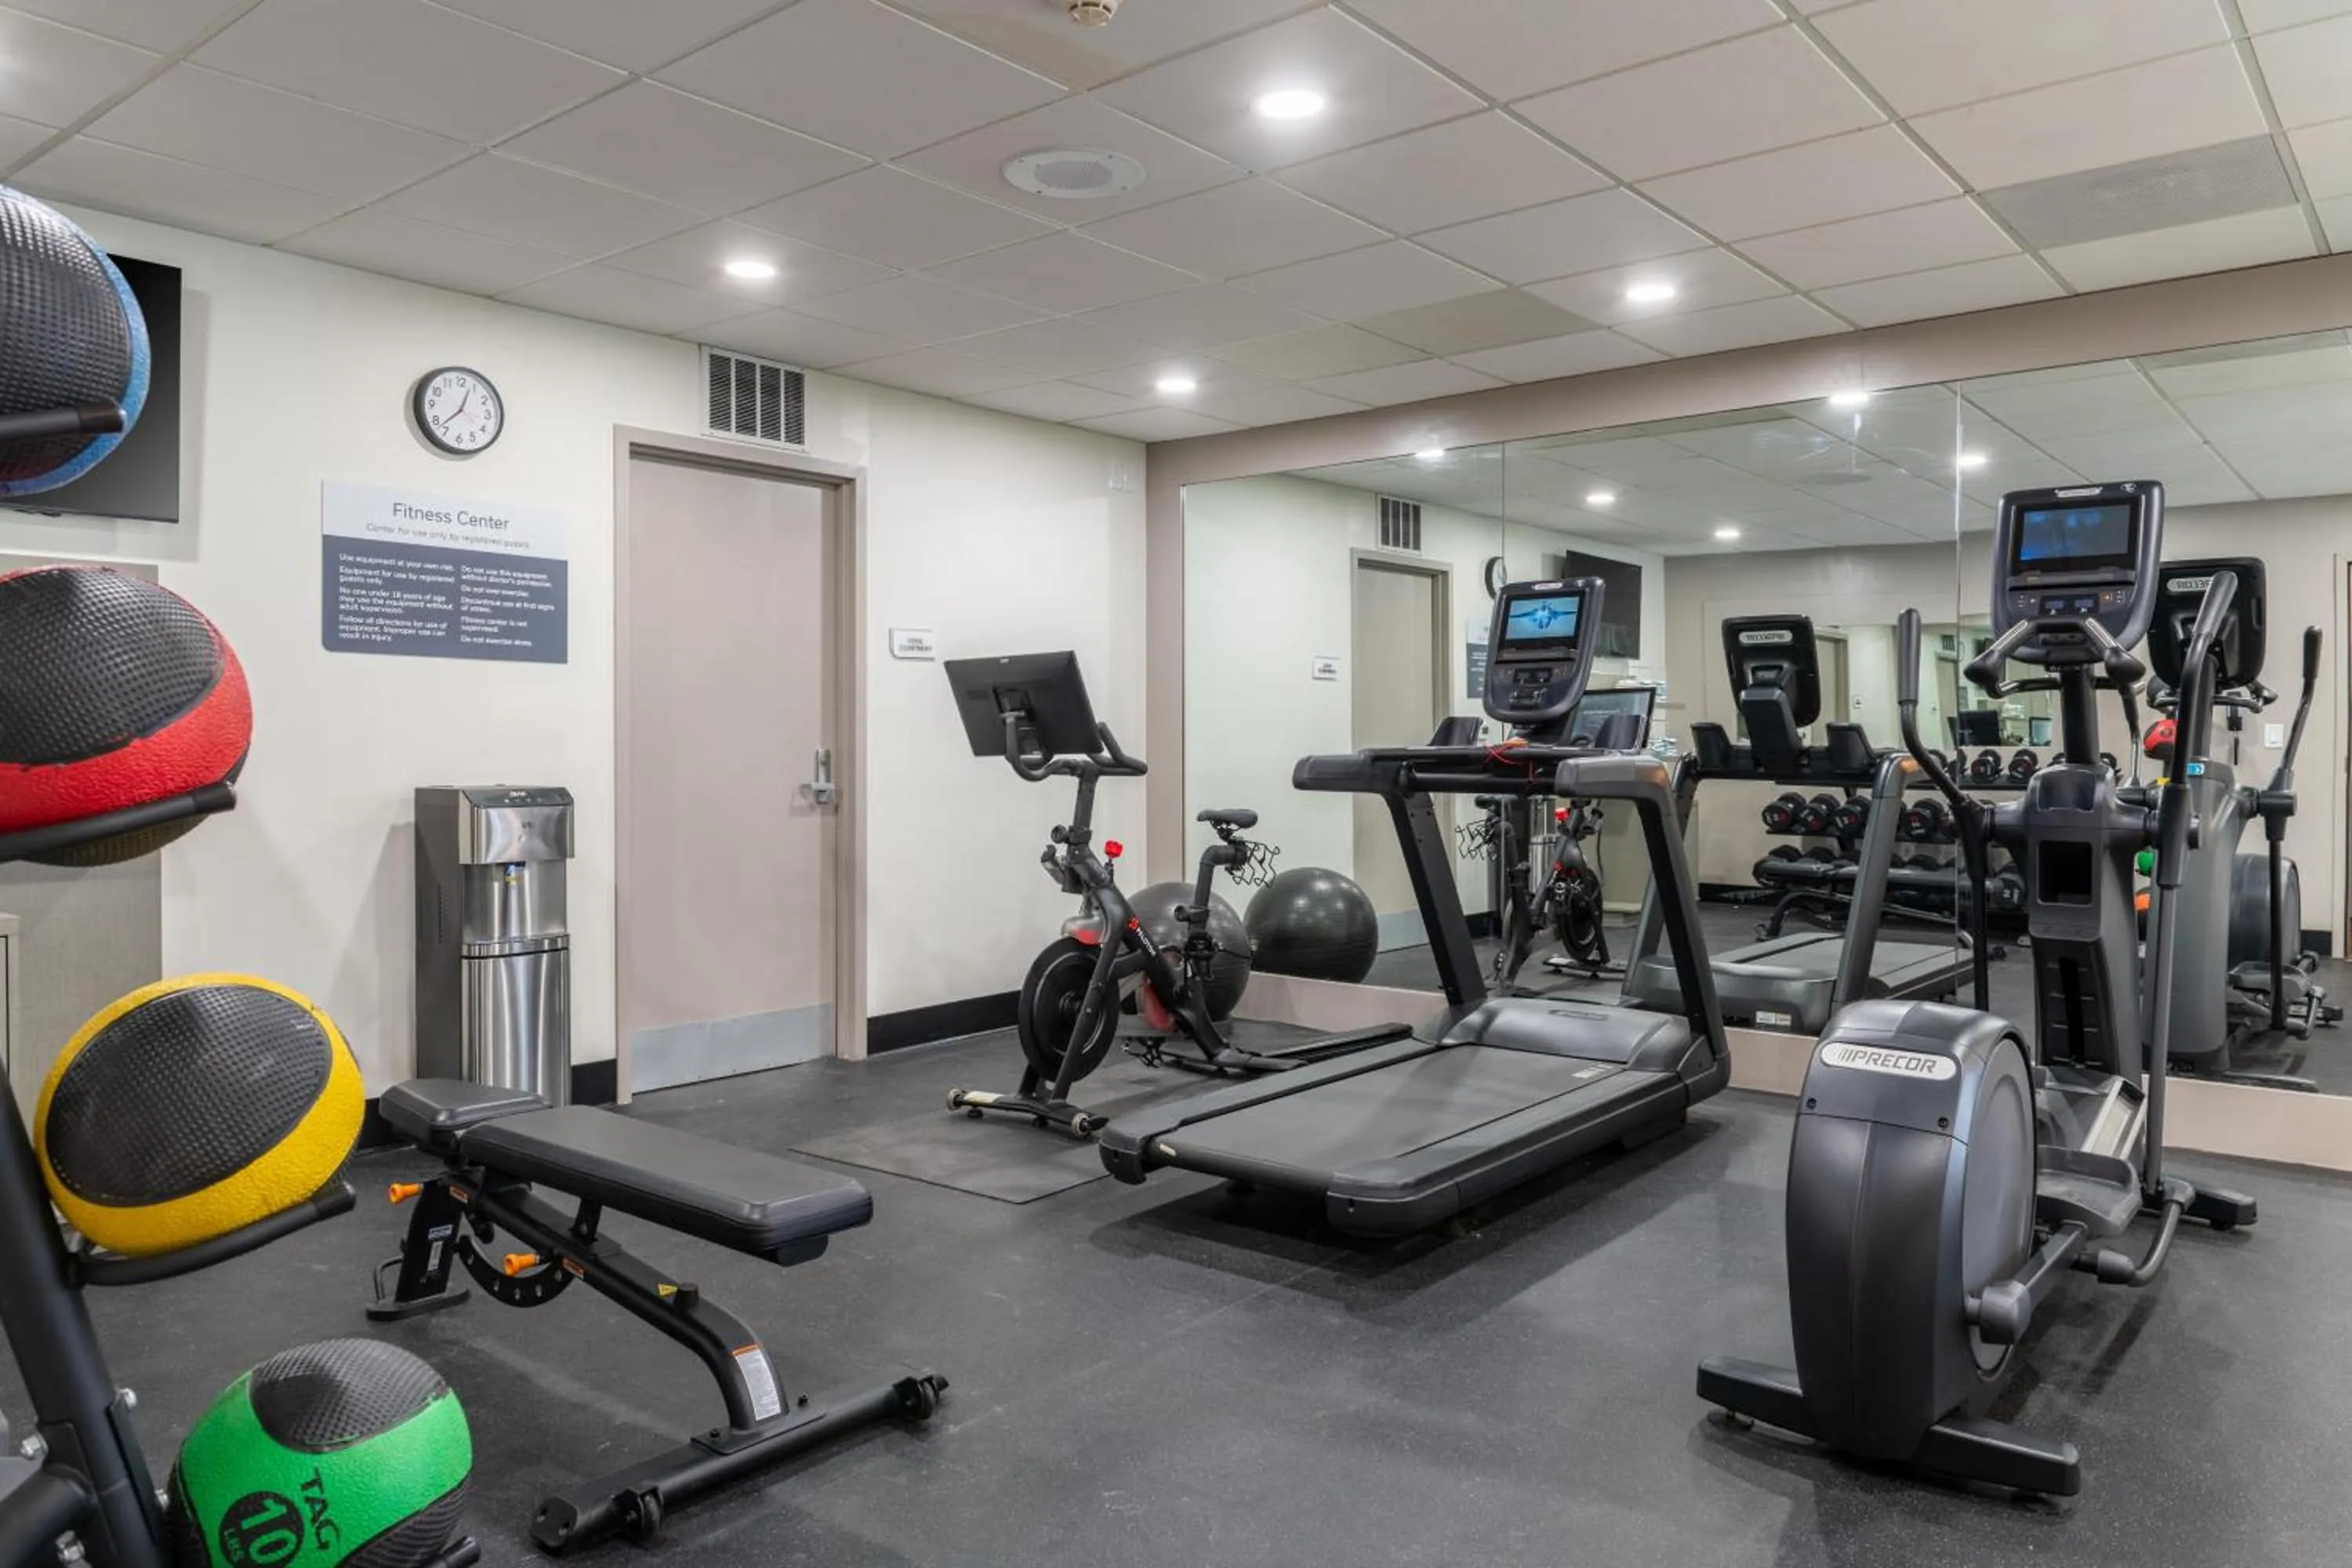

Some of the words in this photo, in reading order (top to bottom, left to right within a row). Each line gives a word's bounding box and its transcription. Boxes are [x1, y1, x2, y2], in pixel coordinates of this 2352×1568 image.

[393, 503, 452, 524] Fitness
[457, 510, 510, 530] Center
[1852, 1051, 1937, 1073] PRECOR
[240, 1498, 298, 1565] 10
[301, 1467, 340, 1551] TAG
